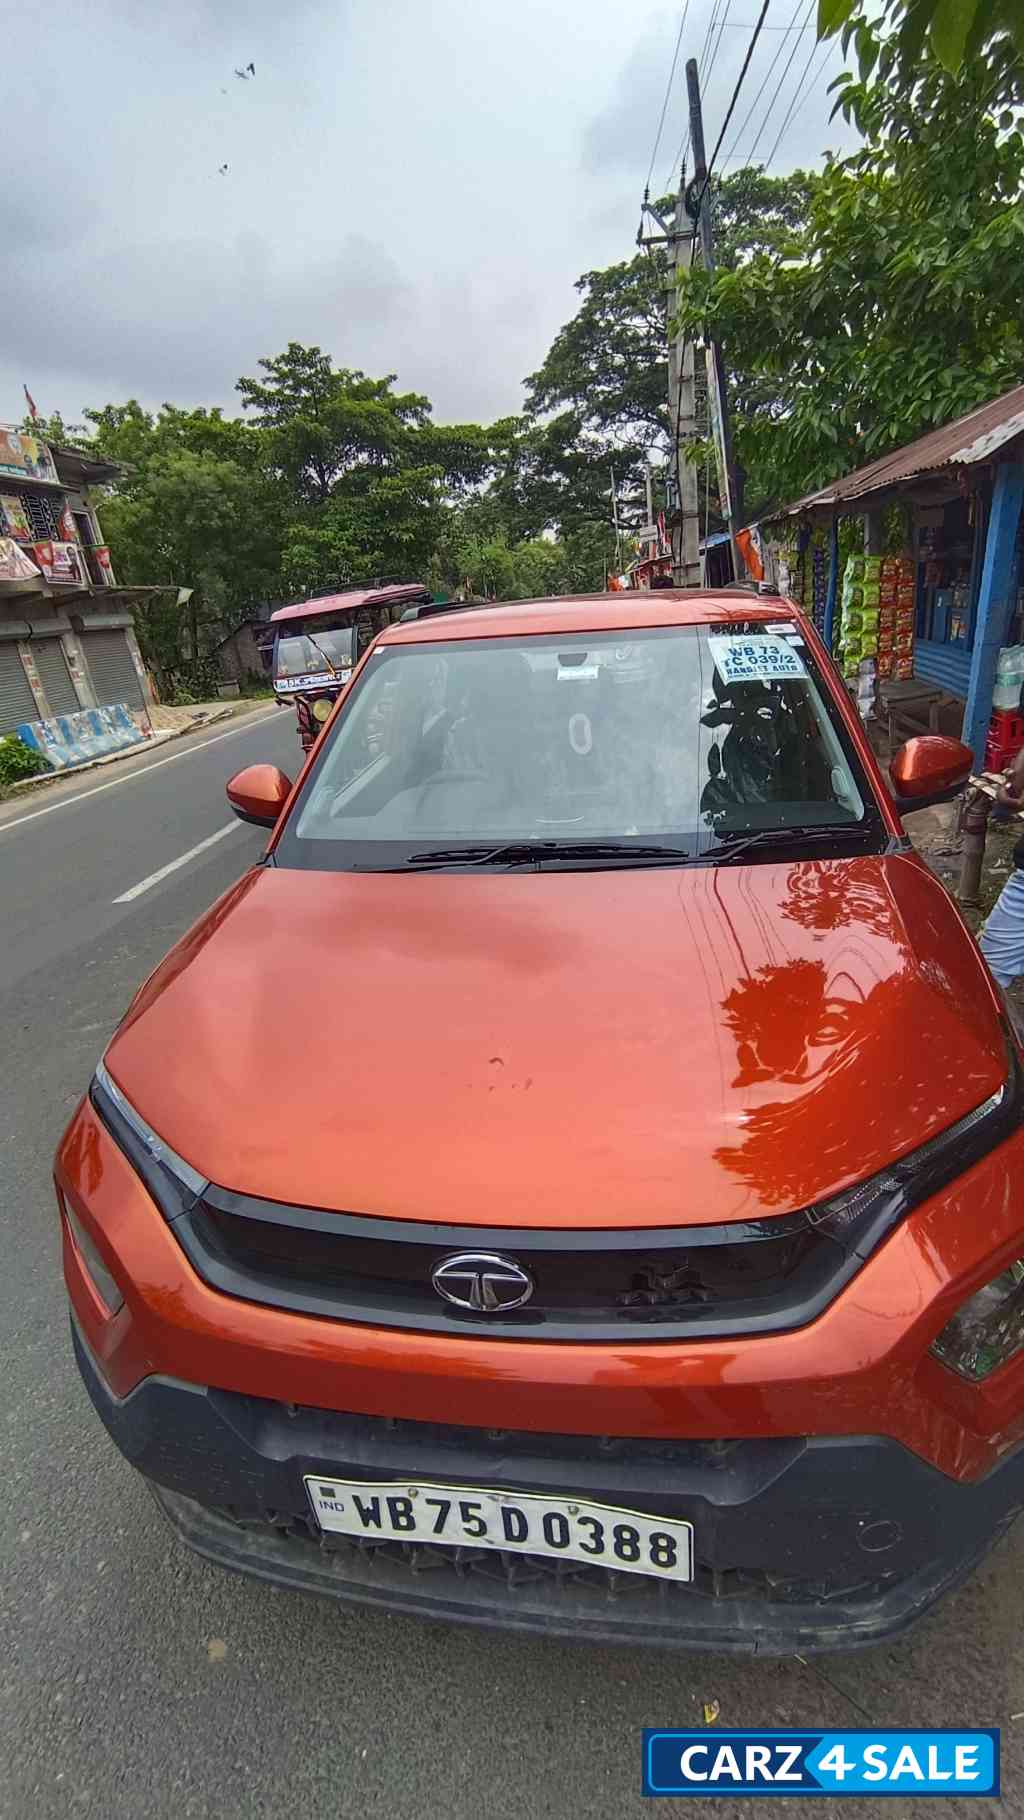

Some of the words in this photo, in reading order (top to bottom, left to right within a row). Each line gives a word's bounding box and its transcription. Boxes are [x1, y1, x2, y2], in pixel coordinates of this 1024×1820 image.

[728, 647, 755, 656] WB
[759, 646, 780, 655] 73
[318, 1500, 345, 1513] IND
